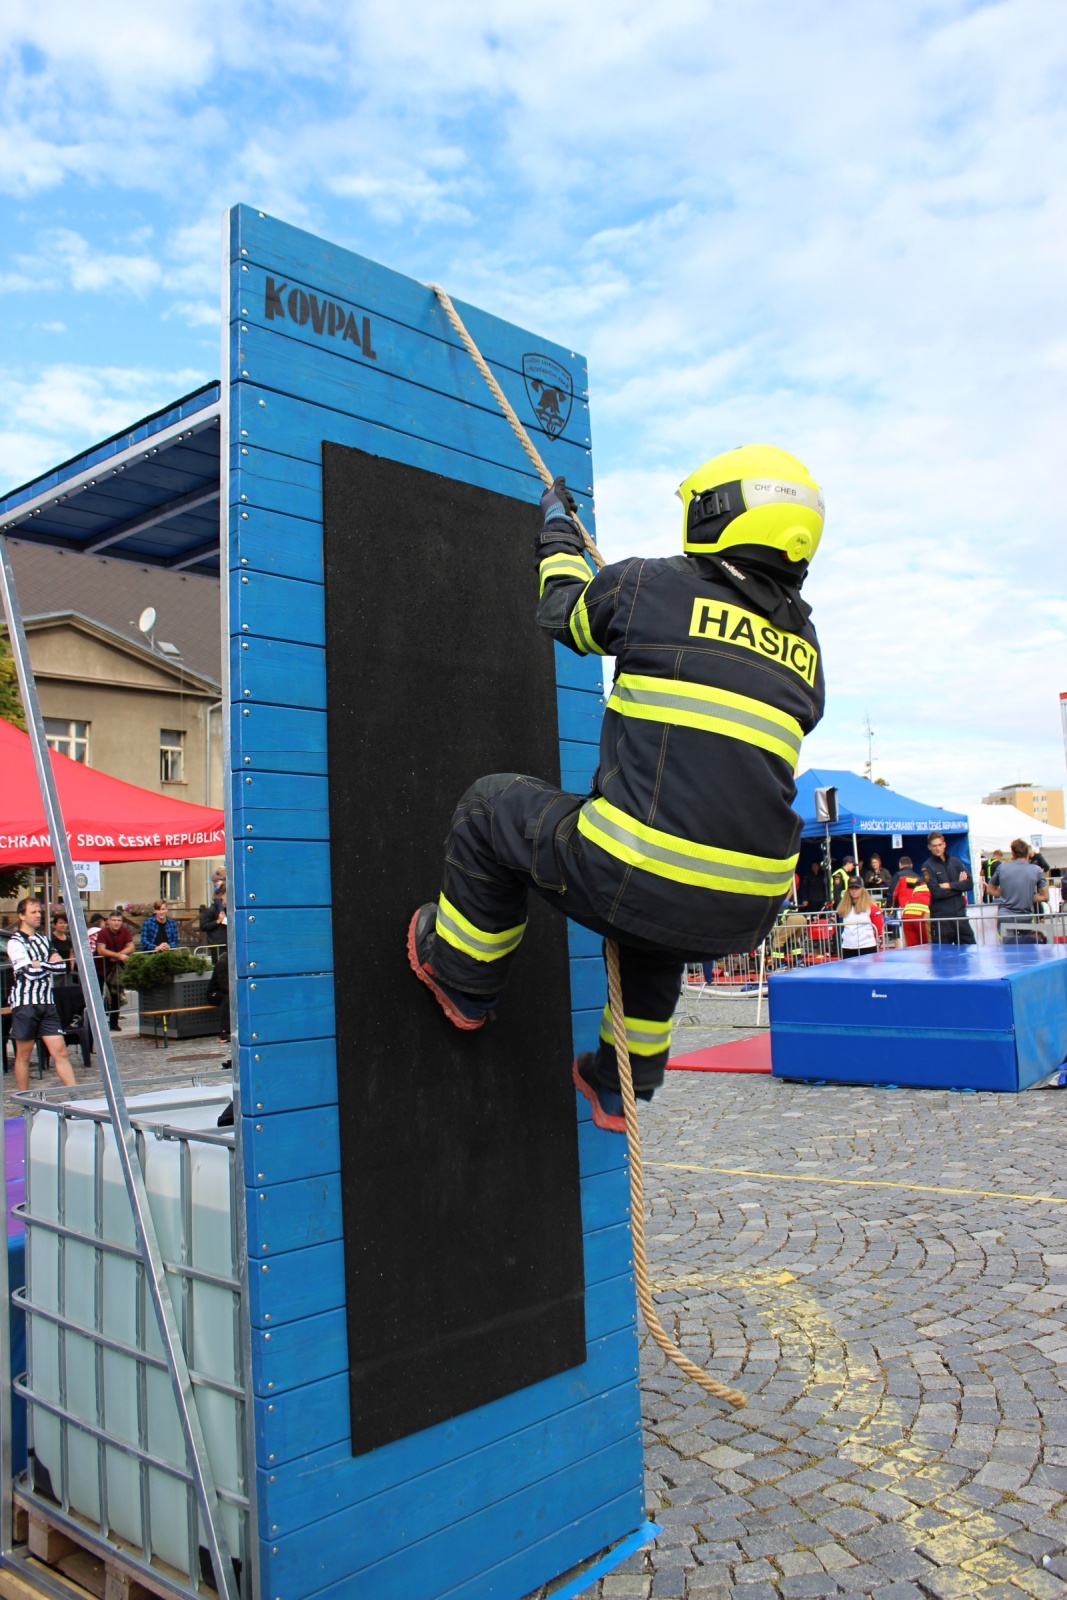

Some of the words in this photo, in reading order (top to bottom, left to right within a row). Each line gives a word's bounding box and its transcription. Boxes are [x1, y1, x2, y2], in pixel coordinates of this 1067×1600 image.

[265, 276, 377, 360] KOVPAL
[774, 486, 797, 497] CHEB
[699, 605, 815, 681] HASIČI
[77, 834, 115, 847] SBOR
[118, 833, 161, 847] ČESKÉ
[86, 863, 91, 871] 2
